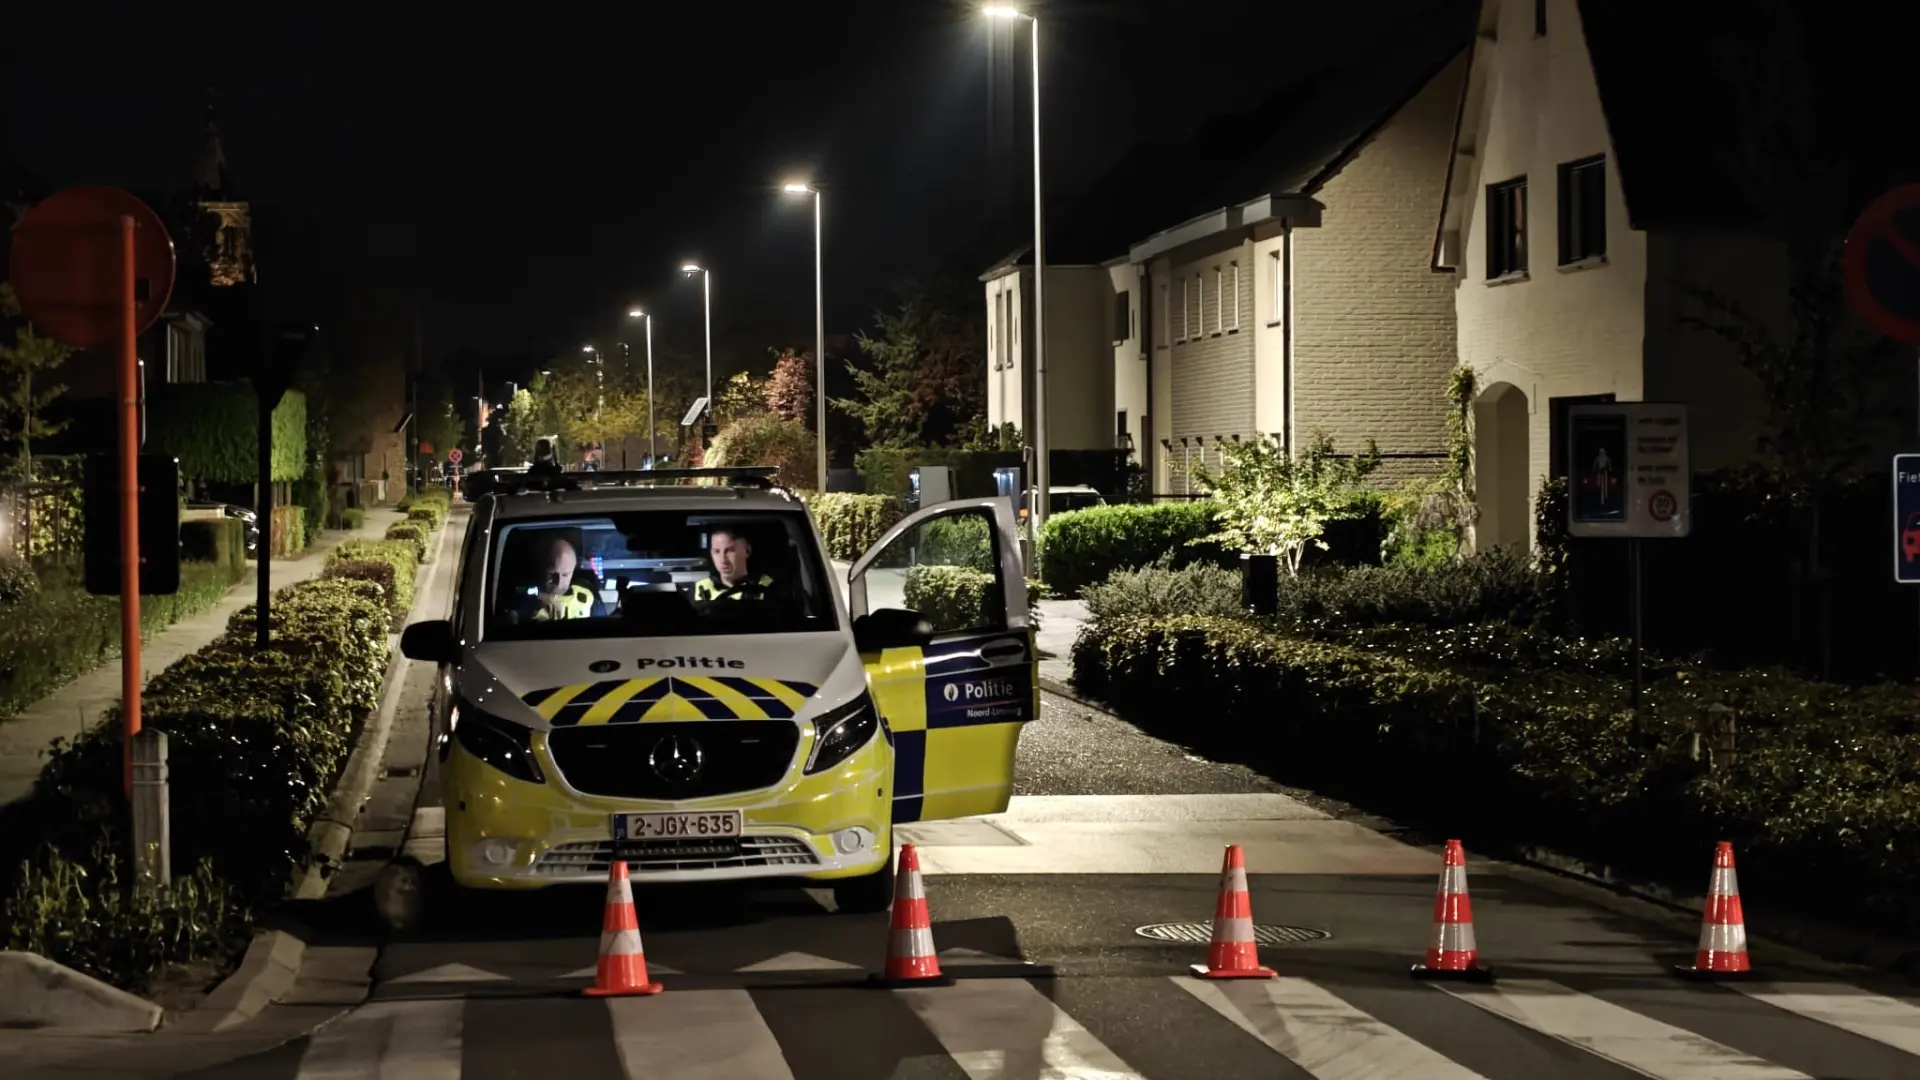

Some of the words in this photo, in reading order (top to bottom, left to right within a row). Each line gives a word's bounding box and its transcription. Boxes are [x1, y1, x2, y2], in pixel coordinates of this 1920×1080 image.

[638, 656, 745, 669] Politie
[965, 680, 1014, 700] Politie
[634, 815, 734, 836] 2-JGX-635
